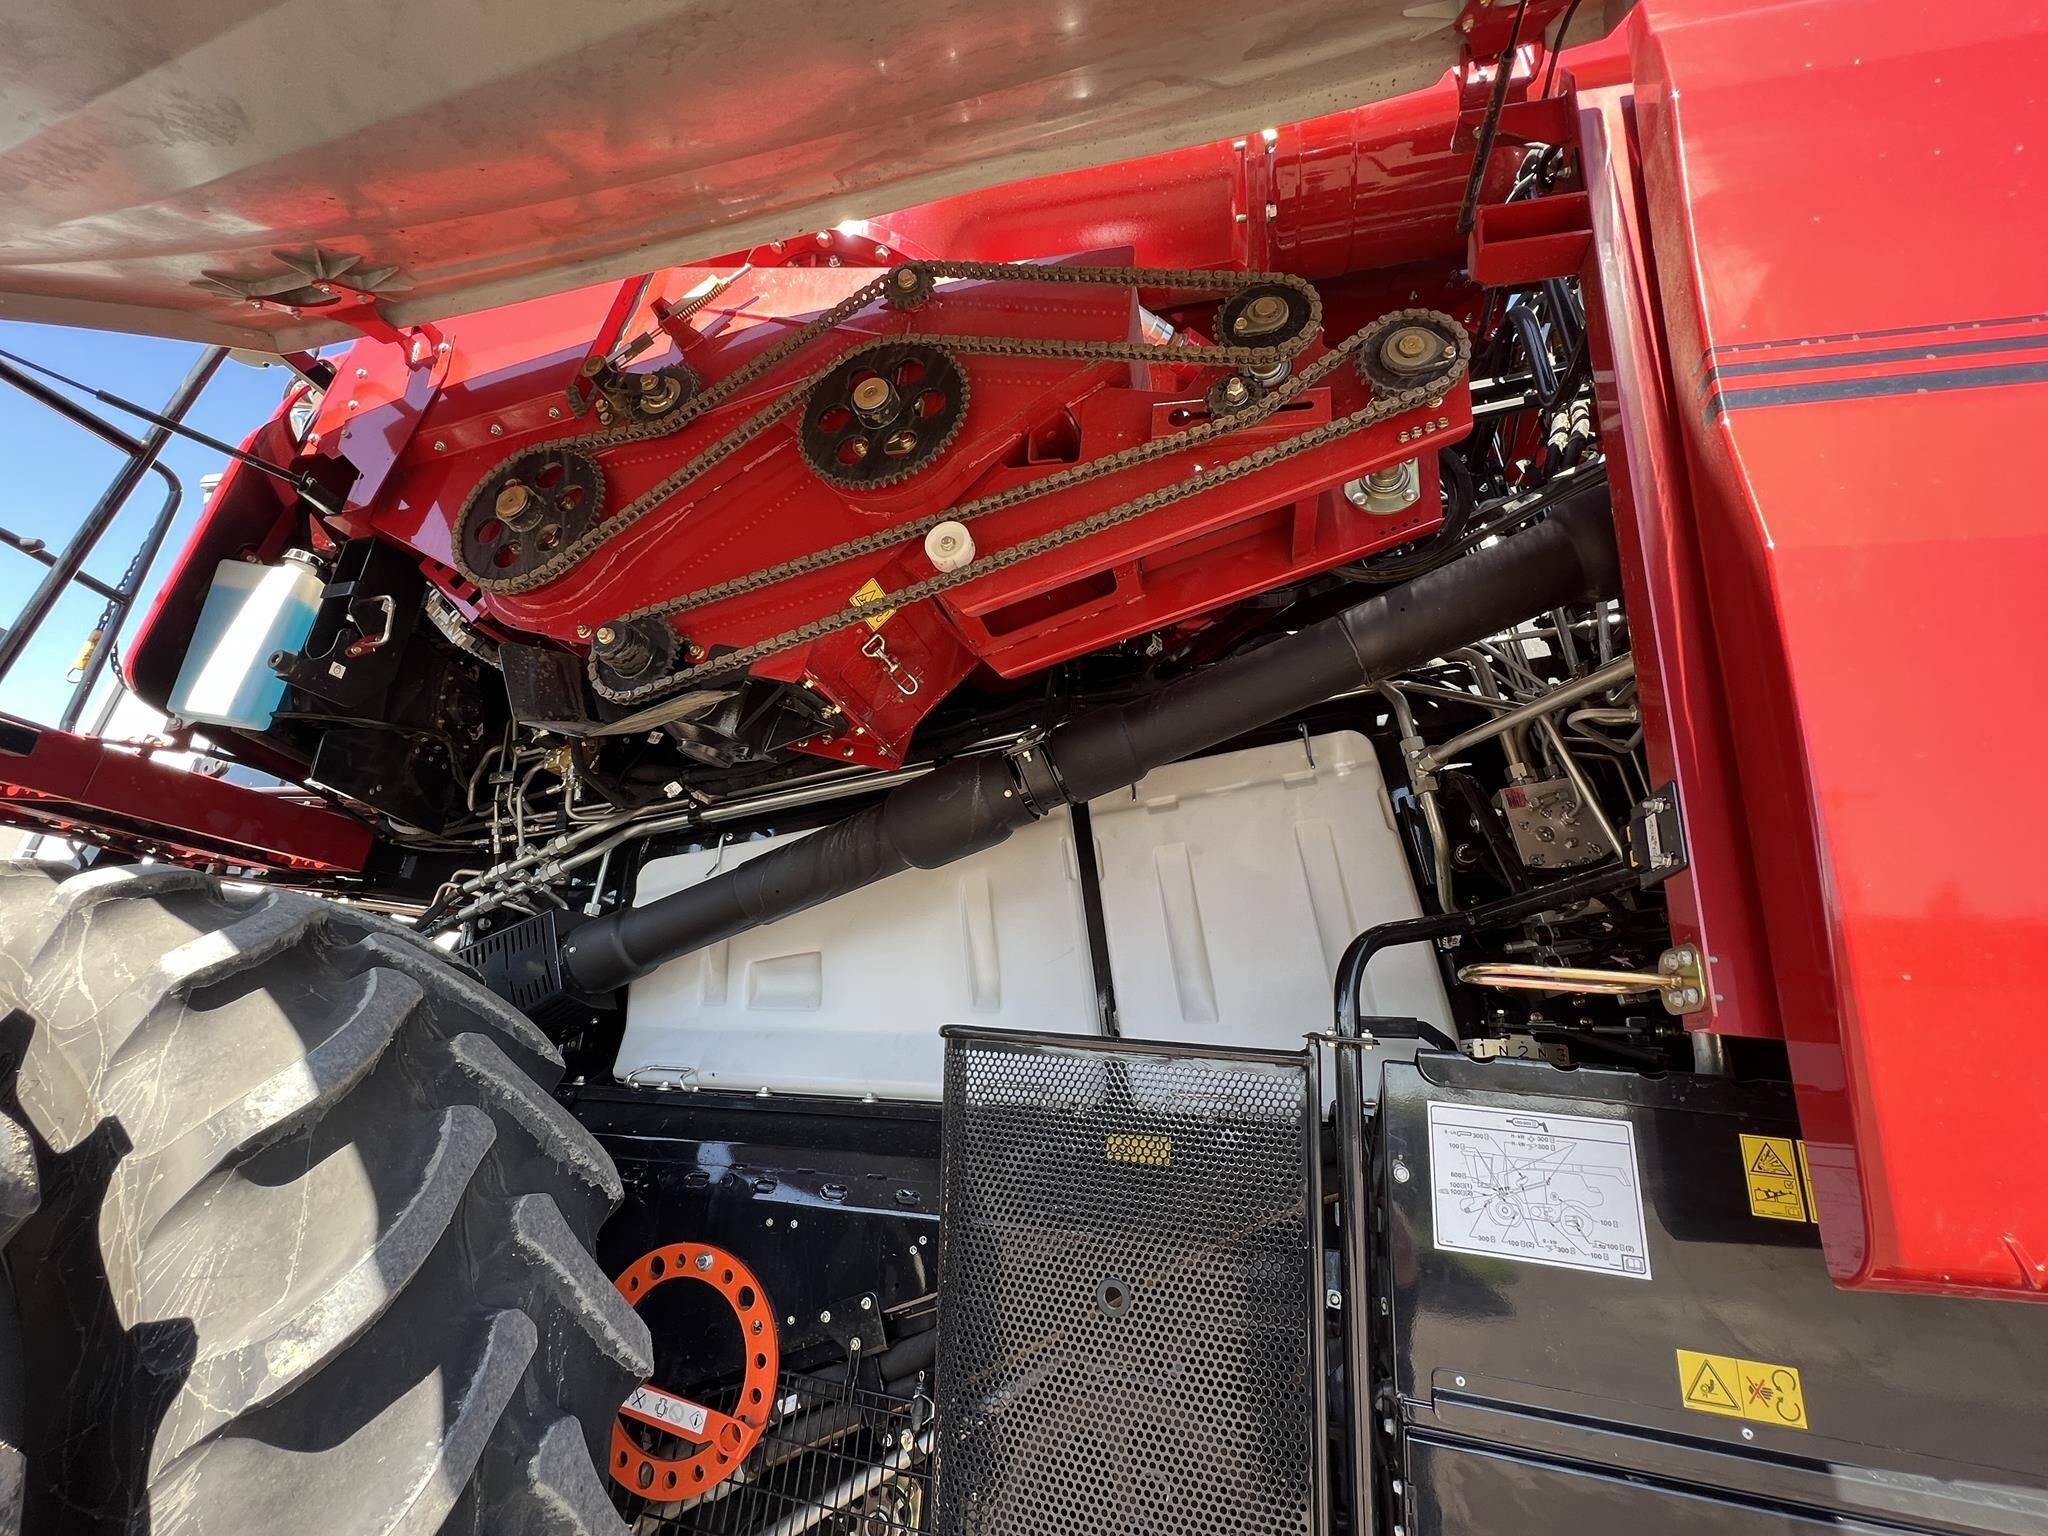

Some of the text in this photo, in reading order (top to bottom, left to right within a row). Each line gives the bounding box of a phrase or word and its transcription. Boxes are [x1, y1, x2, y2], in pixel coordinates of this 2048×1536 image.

[1479, 1043, 1567, 1062] 1 N 2 N 3
[1557, 1246, 1569, 1254] 300
[1590, 1252, 1602, 1260] 100
